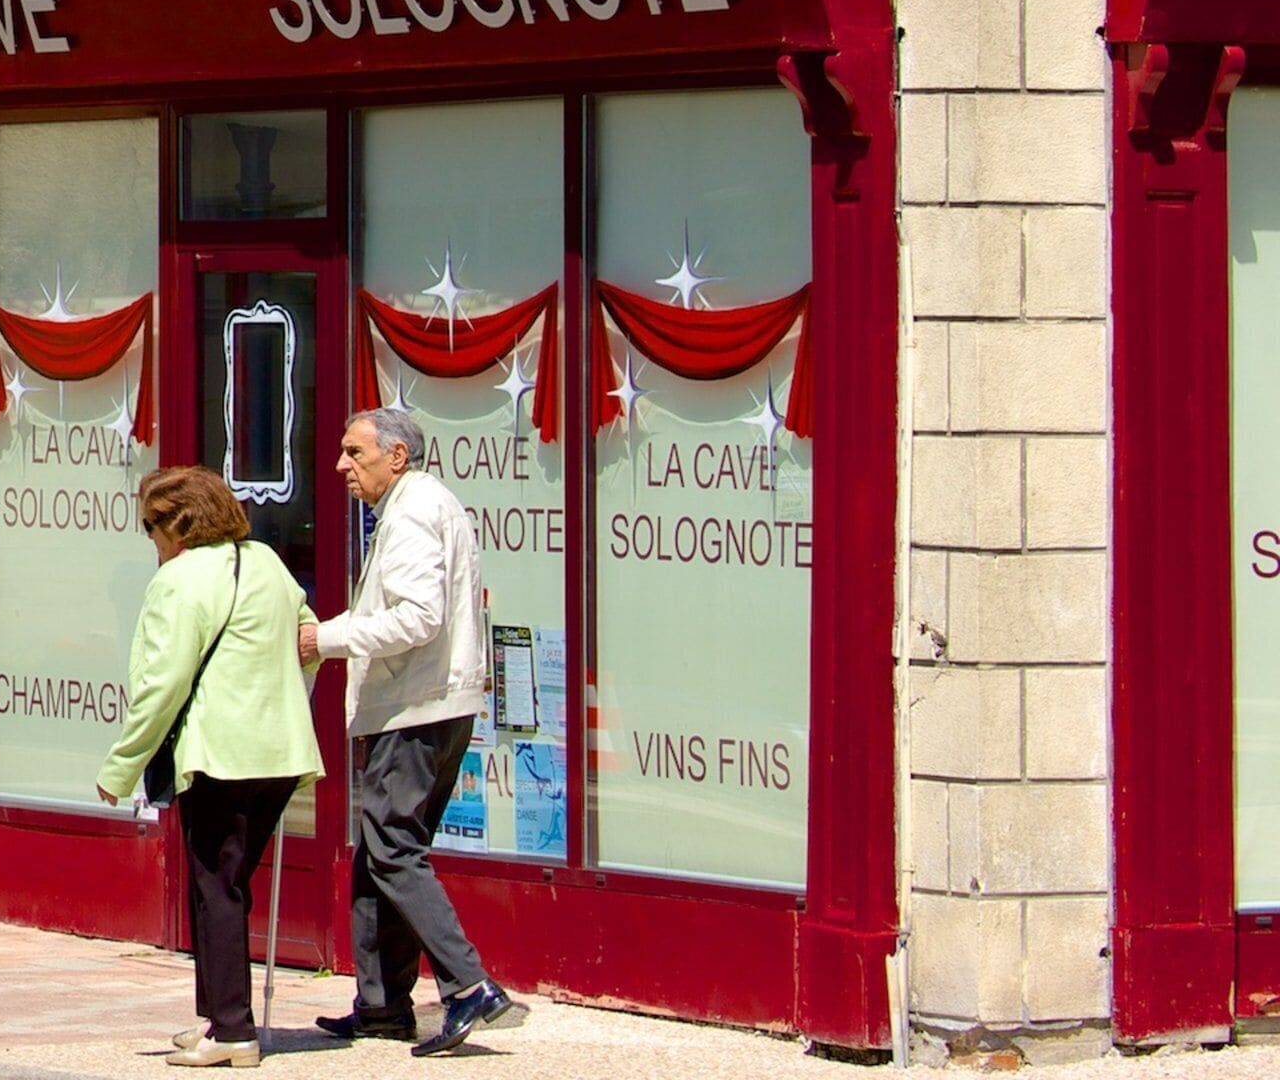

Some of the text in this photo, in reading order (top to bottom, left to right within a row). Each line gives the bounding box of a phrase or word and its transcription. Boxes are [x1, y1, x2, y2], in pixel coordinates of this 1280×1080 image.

[32, 424, 133, 466] LA CAVE
[424, 436, 530, 480] A CAVE
[647, 442, 777, 491] LA CAVE
[3, 487, 141, 533] SOLOGNOT
[610, 513, 813, 568] SOLOGNOTE
[633, 730, 791, 791] VINS FINS
